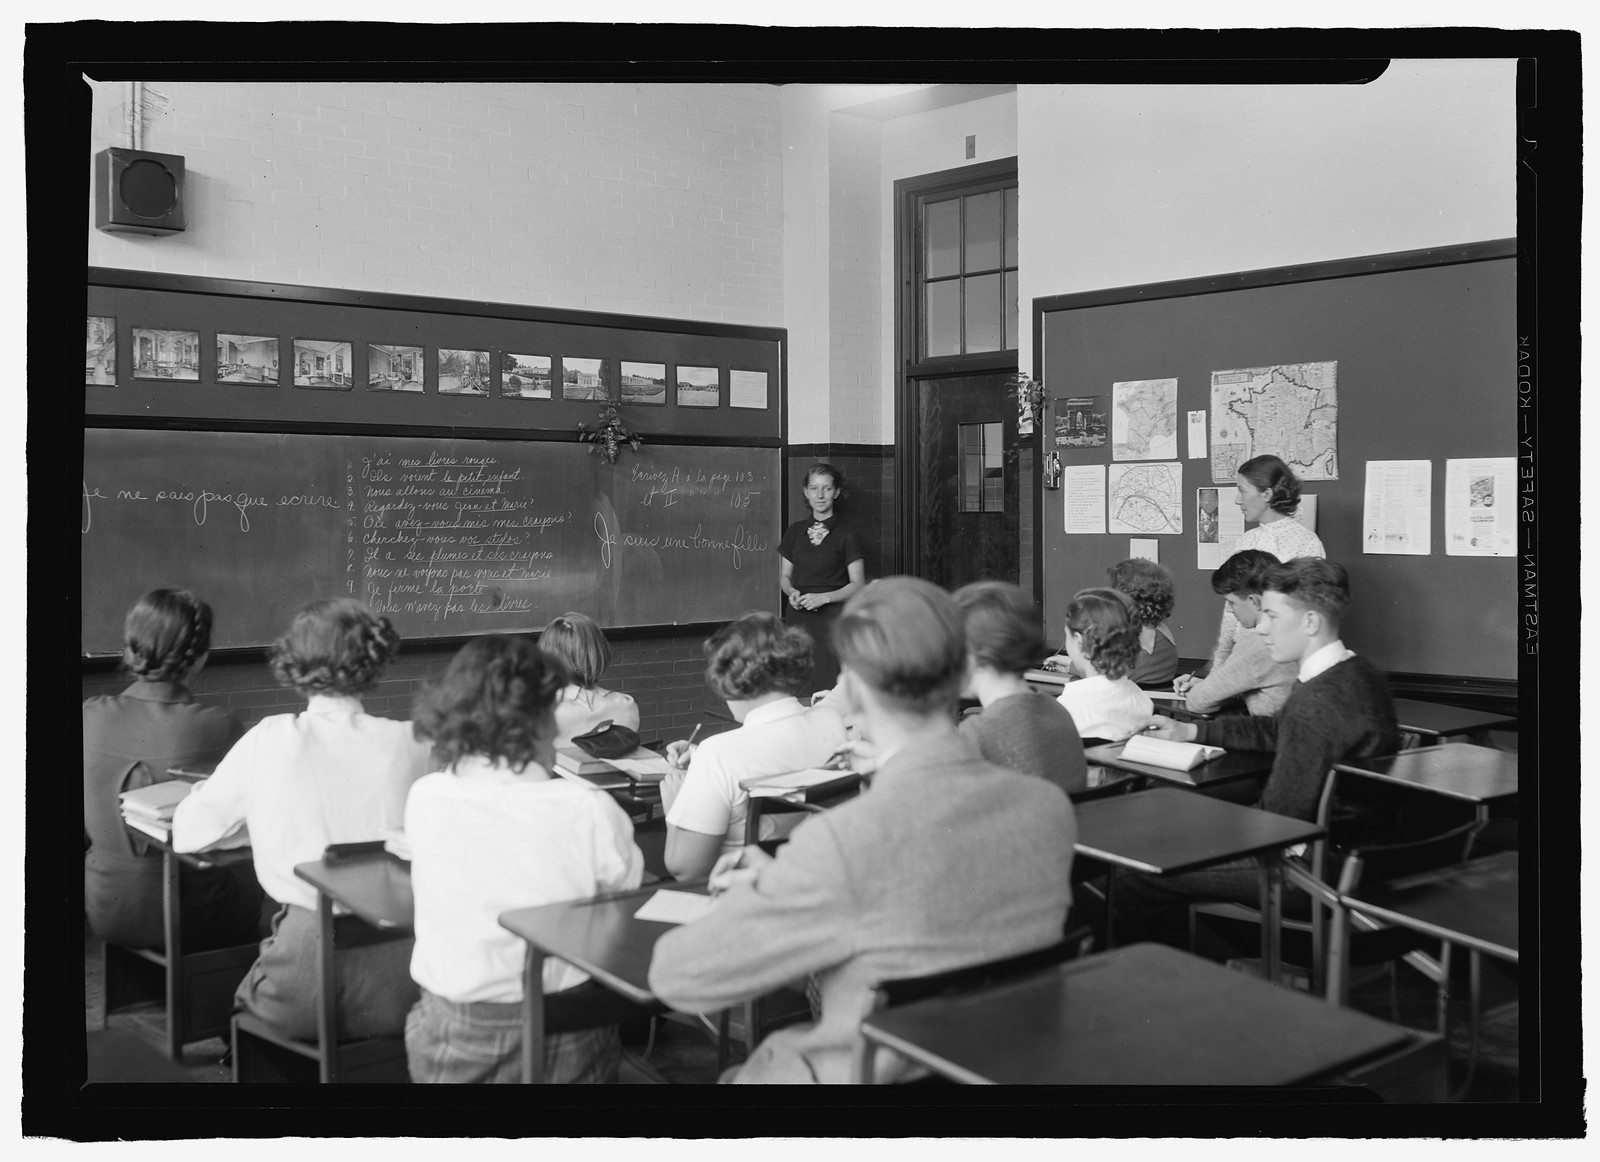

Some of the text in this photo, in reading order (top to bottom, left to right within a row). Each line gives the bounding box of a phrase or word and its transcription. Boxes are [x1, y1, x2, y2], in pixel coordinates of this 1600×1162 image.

[362, 452, 391, 478] J'ai
[399, 458, 421, 466] mes
[427, 451, 458, 466] livres
[400, 469, 437, 482] voient
[441, 470, 453, 482] le
[455, 471, 484, 491] petit
[672, 466, 680, 483] A
[696, 468, 707, 483] la
[708, 472, 732, 491] page
[395, 485, 435, 496] allons
[641, 485, 659, 506] et
[729, 491, 761, 508] 105
[116, 490, 148, 500] ne
[156, 489, 194, 502] sais
[194, 489, 232, 525] pas
[234, 493, 268, 532] que
[364, 498, 449, 520] Regardez-vous
[485, 499, 498, 510] et
[464, 515, 489, 528] mis
[493, 519, 519, 528] mes
[459, 535, 480, 544] vos
[594, 512, 767, 569] Je suis une bonne fille
[365, 547, 380, 562] Il
[385, 551, 396, 560] a
[428, 547, 468, 567] plumes
[471, 546, 483, 560] et
[395, 567, 410, 578] ne
[412, 567, 448, 586] voyons
[450, 567, 472, 586] pas
[501, 563, 520, 578] et
[367, 581, 382, 607] Je
[387, 582, 424, 606] ferme
[429, 580, 444, 593] la
[447, 581, 488, 602] porte
[404, 600, 441, 621] n'avez
[444, 601, 465, 620] pas
[468, 598, 491, 612] les
